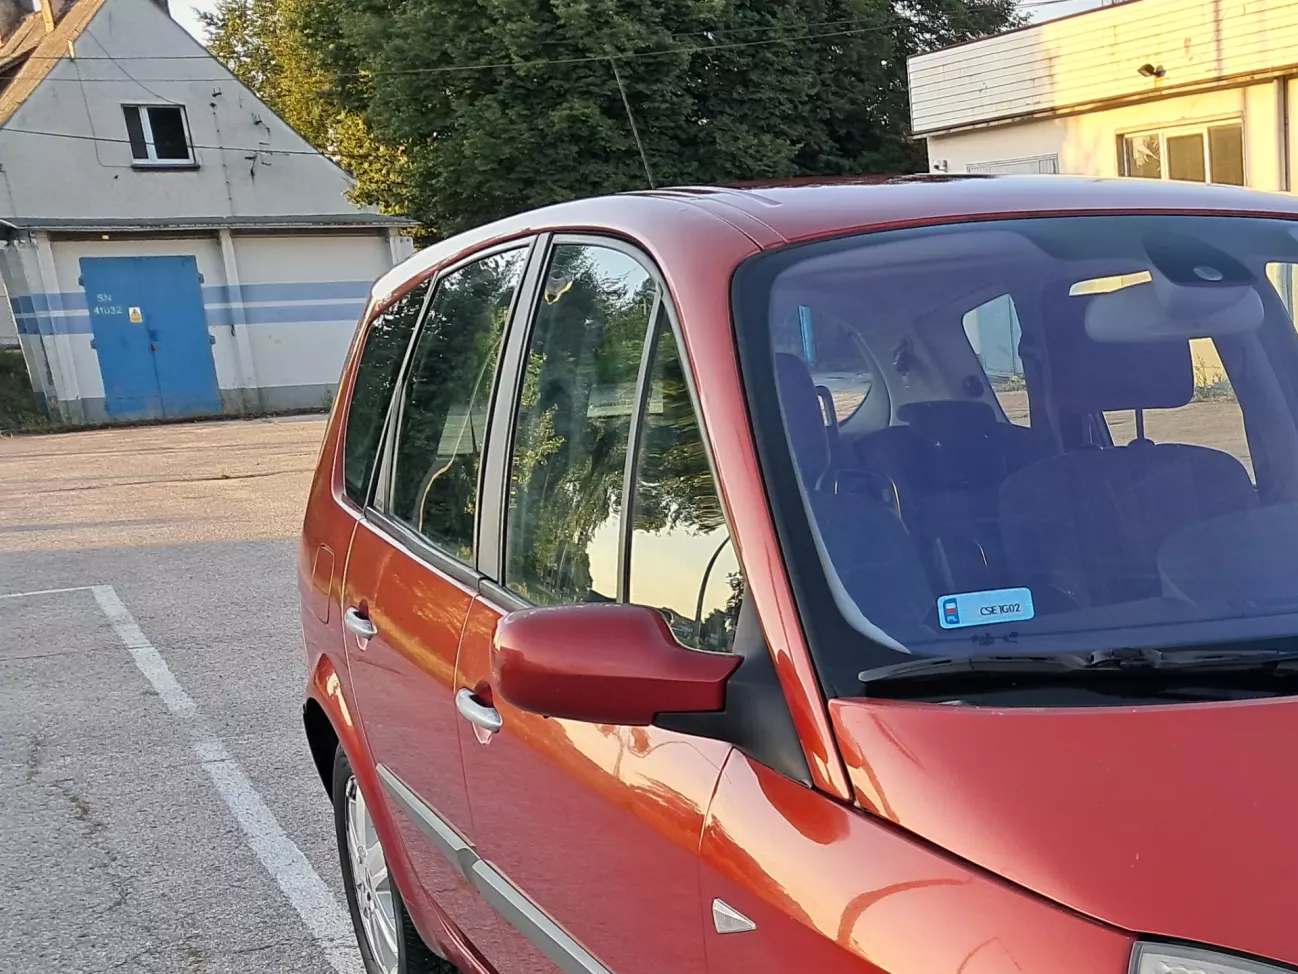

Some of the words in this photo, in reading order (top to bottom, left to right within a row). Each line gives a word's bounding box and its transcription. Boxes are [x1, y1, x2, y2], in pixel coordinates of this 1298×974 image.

[980, 606, 999, 616] CSE
[1000, 603, 1021, 613] 1G02
[947, 615, 958, 623] PL
